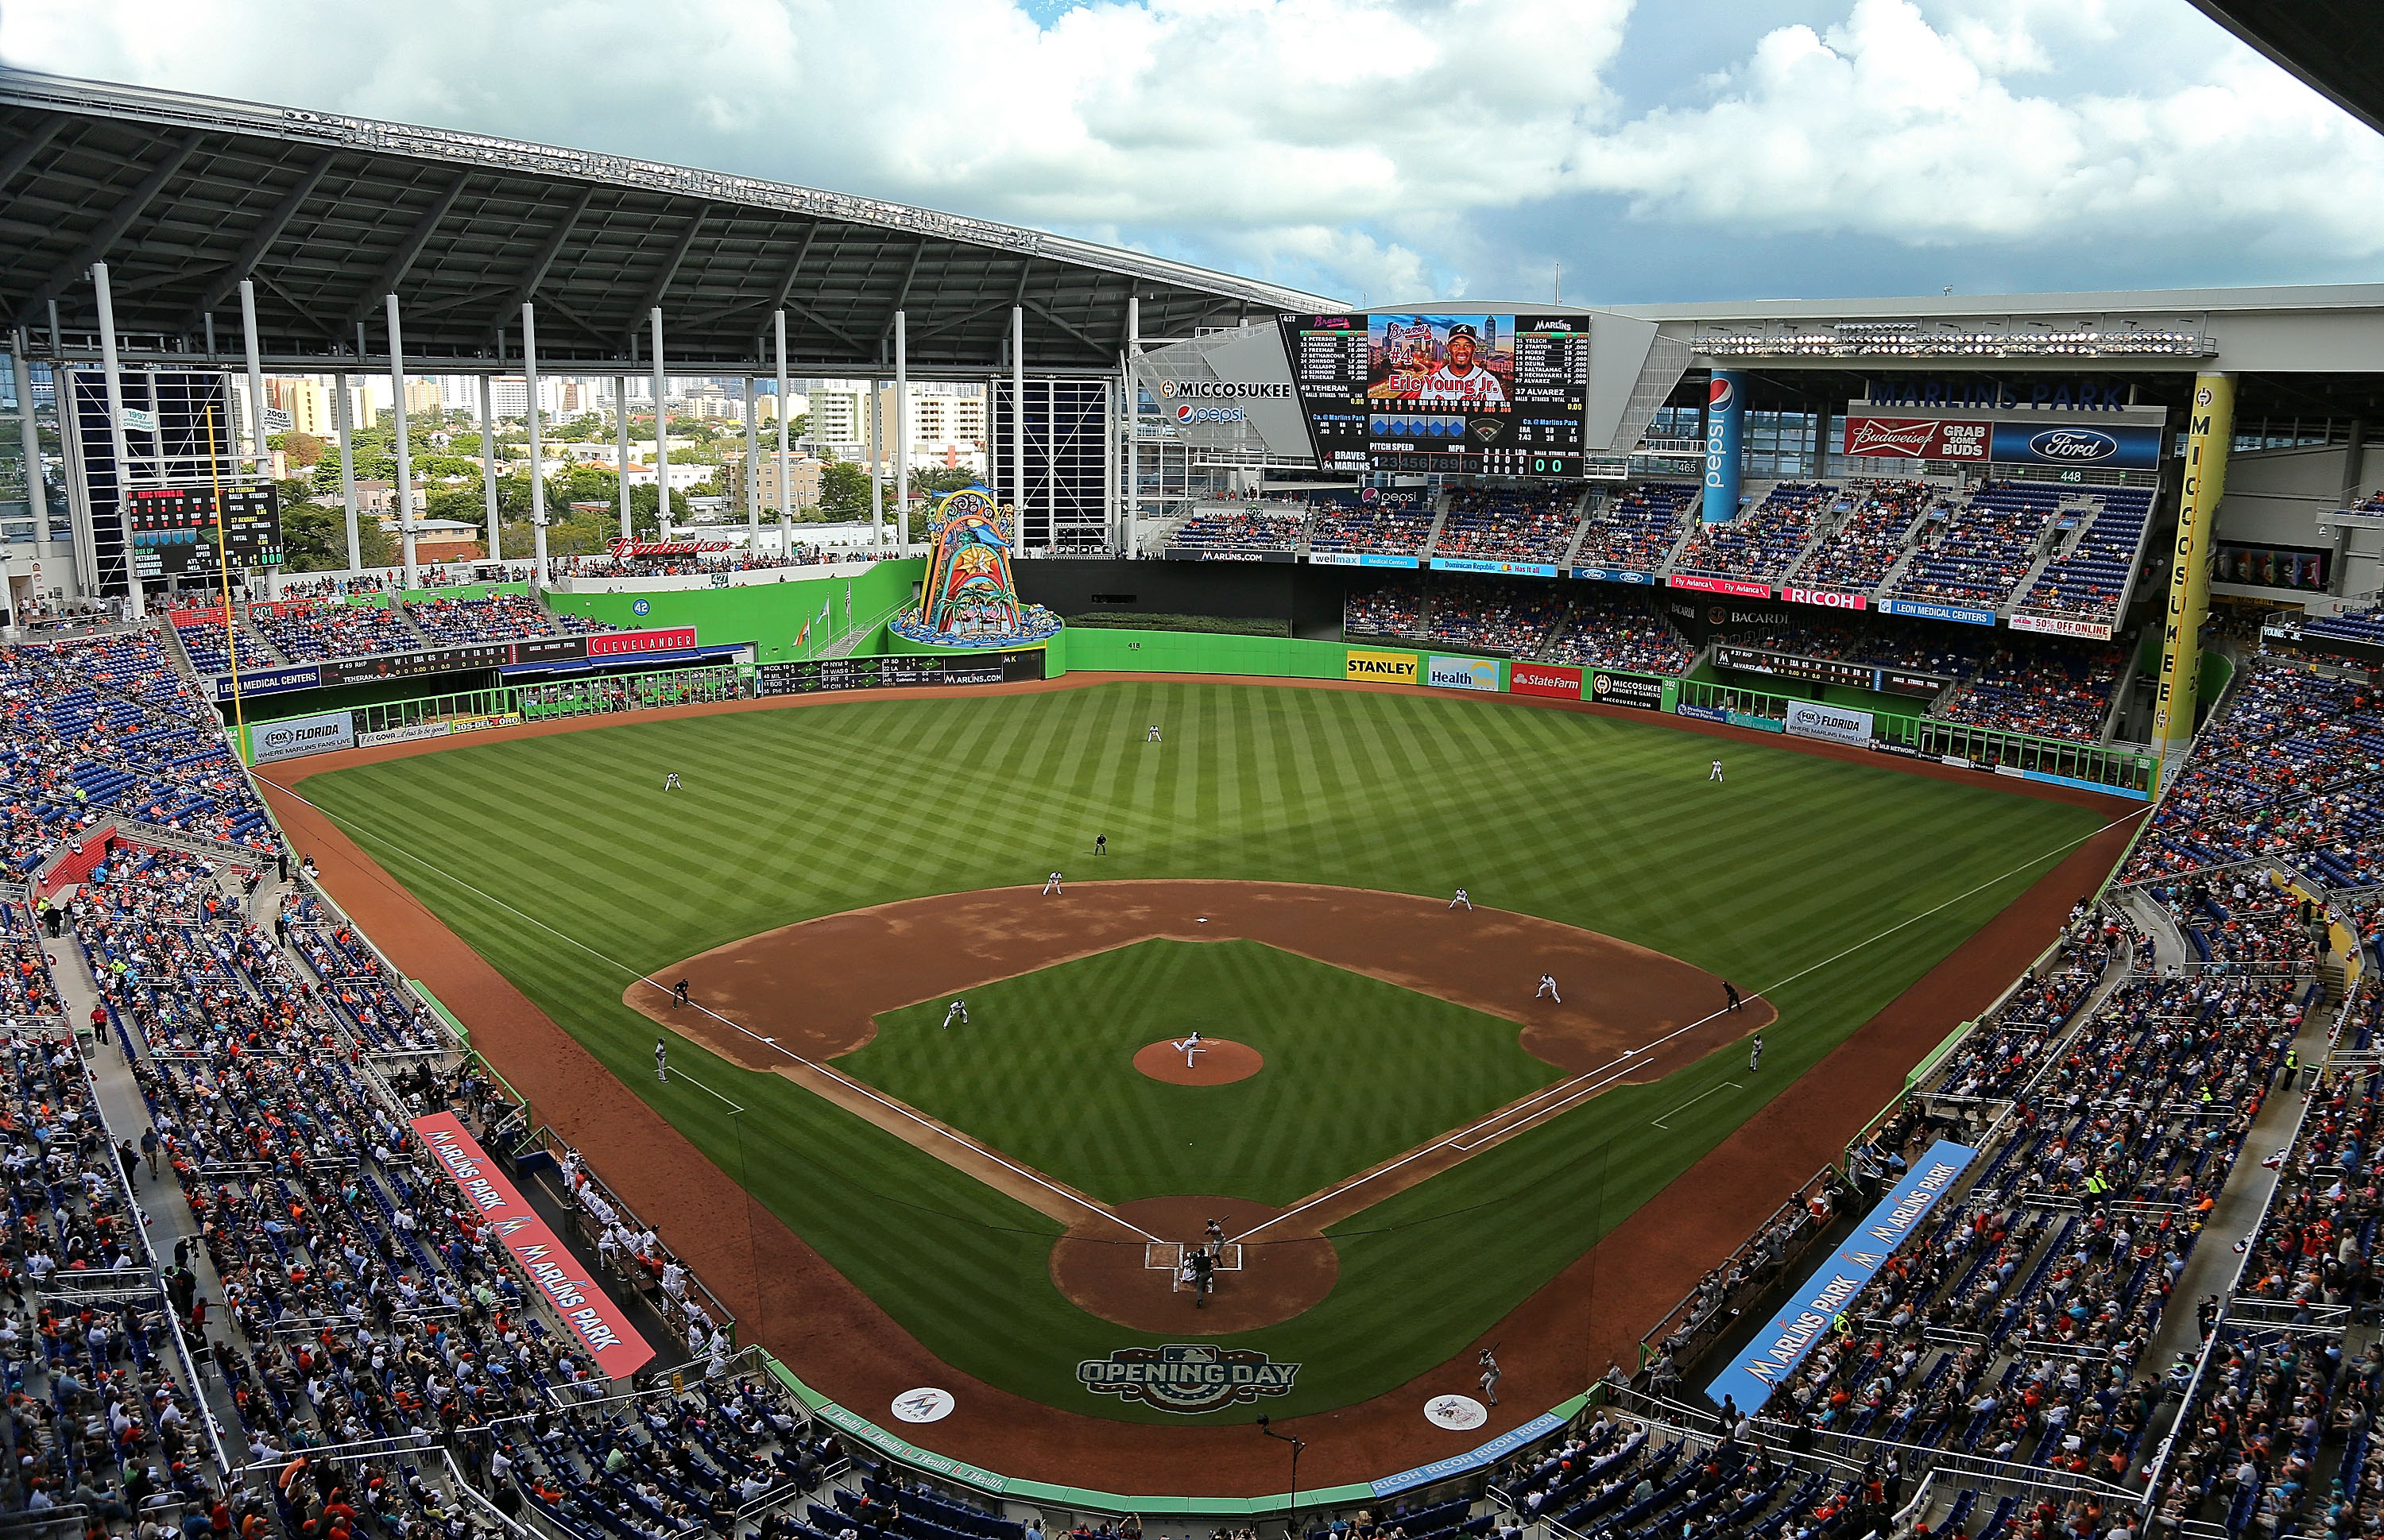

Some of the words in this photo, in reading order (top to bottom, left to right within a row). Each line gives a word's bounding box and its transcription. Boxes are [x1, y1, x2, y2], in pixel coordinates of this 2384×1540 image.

[1389, 323, 1426, 339] Braves
[1534, 319, 1572, 331] MARLINS
[1389, 347, 1413, 365] #4
[1178, 382, 1291, 397] MICCOSUKEE
[1390, 375, 1422, 390] Eric
[1424, 376, 1476, 393] Young
[1478, 377, 1499, 392] Jr.
[1870, 381, 2017, 409] MARLINS
[2031, 383, 2125, 412] PARK
[128, 411, 147, 420] 1997
[266, 409, 288, 420] 2003
[1195, 406, 1244, 424] pepsi
[122, 422, 155, 431] CHAMPIONS
[264, 420, 292, 429] CHAMPIONS
[1943, 425, 1986, 438] GRAB
[1853, 424, 1934, 445] Budweiser
[1705, 416, 1727, 489] pepsi
[1941, 443, 1983, 456] BUDS
[2045, 432, 2100, 458] Ford
[1335, 451, 1366, 460] BRAVES
[1335, 462, 1371, 470] MARLINS
[1678, 462, 1697, 473] 465
[2060, 470, 2082, 482] 448
[1382, 491, 1418, 504] pepsi
[606, 536, 733, 559] Budweiser
[1201, 551, 1263, 562] MARLINS.COM
[1315, 554, 1357, 564] wellmax
[2159, 416, 2211, 702] MICCOSUKEE
[1445, 560, 1472, 570] Dominican
[1473, 562, 1496, 572] Republic
[711, 573, 728, 585] 427
[1585, 570, 1604, 578] Ford
[1622, 573, 1642, 582] Ford
[1675, 578, 1684, 586] Fly
[1685, 579, 1709, 588] Avianca
[1724, 582, 1734, 592] Fly
[1736, 585, 1759, 594] Avianca
[1791, 588, 1855, 609] RICOH
[253, 606, 273, 617] 401
[633, 602, 648, 613] 42
[1897, 603, 1917, 614] LEON
[1918, 606, 1951, 618] MEDICAL
[1952, 609, 1987, 622] CENTERS
[2035, 618, 2054, 628] 50%
[2057, 621, 2072, 631] OFF
[2075, 623, 2108, 635] ONLINE
[592, 635, 692, 653] CLEVELANDER
[2290, 632, 2303, 641] JR.
[1348, 660, 1415, 675] STANLEY
[1732, 662, 1755, 671] ALVAREZ
[243, 678, 281, 691] MEDICAL
[281, 672, 317, 685] CENTERS
[343, 674, 373, 683] TEHERAN
[943, 674, 1001, 684] MARLINS.COM
[1664, 679, 1675, 688] 392
[1612, 679, 1662, 694] MICCOSUKEE
[1612, 687, 1633, 696] RESORT
[1639, 690, 1661, 698] GAMING
[1602, 696, 1651, 708] MICCOSUKEE.COM
[1686, 706, 1713, 715] Preferred
[1700, 712, 1724, 722] Partners
[1802, 712, 1816, 721] FOX
[1821, 715, 1860, 731] FLORIDA
[270, 731, 288, 740] FOX
[296, 724, 339, 741] FLORIDA
[375, 732, 396, 741] GOYA
[1789, 724, 1811, 733] WHERE
[1811, 728, 1838, 738] MARLINS
[1838, 732, 1855, 741] FANS
[258, 749, 284, 759] WHERE
[285, 744, 316, 754] MARLINS
[318, 741, 336, 749] FANS
[1891, 745, 1917, 756] NETWORK
[424, 1129, 481, 1179] MARLINS
[465, 1177, 507, 1212] PARK
[1868, 1190, 1934, 1245] MARLINS
[1918, 1162, 1960, 1193] PARK
[514, 1243, 586, 1309] MARLINS
[568, 1302, 623, 1352] PARK
[1742, 1310, 1828, 1386] MARLINS
[1809, 1274, 1861, 1314] PARK
[1082, 1363, 1225, 1383] OPENING
[1232, 1364, 1298, 1384] DAY
[821, 1405, 861, 1431] UHealth
[1518, 1413, 1558, 1438] RICOH
[860, 1426, 904, 1453] UHealth
[1473, 1434, 1517, 1459] RICOH
[901, 1448, 952, 1472] UHealth
[1426, 1453, 1475, 1474] RICOH
[953, 1465, 1004, 1490] UHealth
[1372, 1470, 1422, 1491] RICOH
